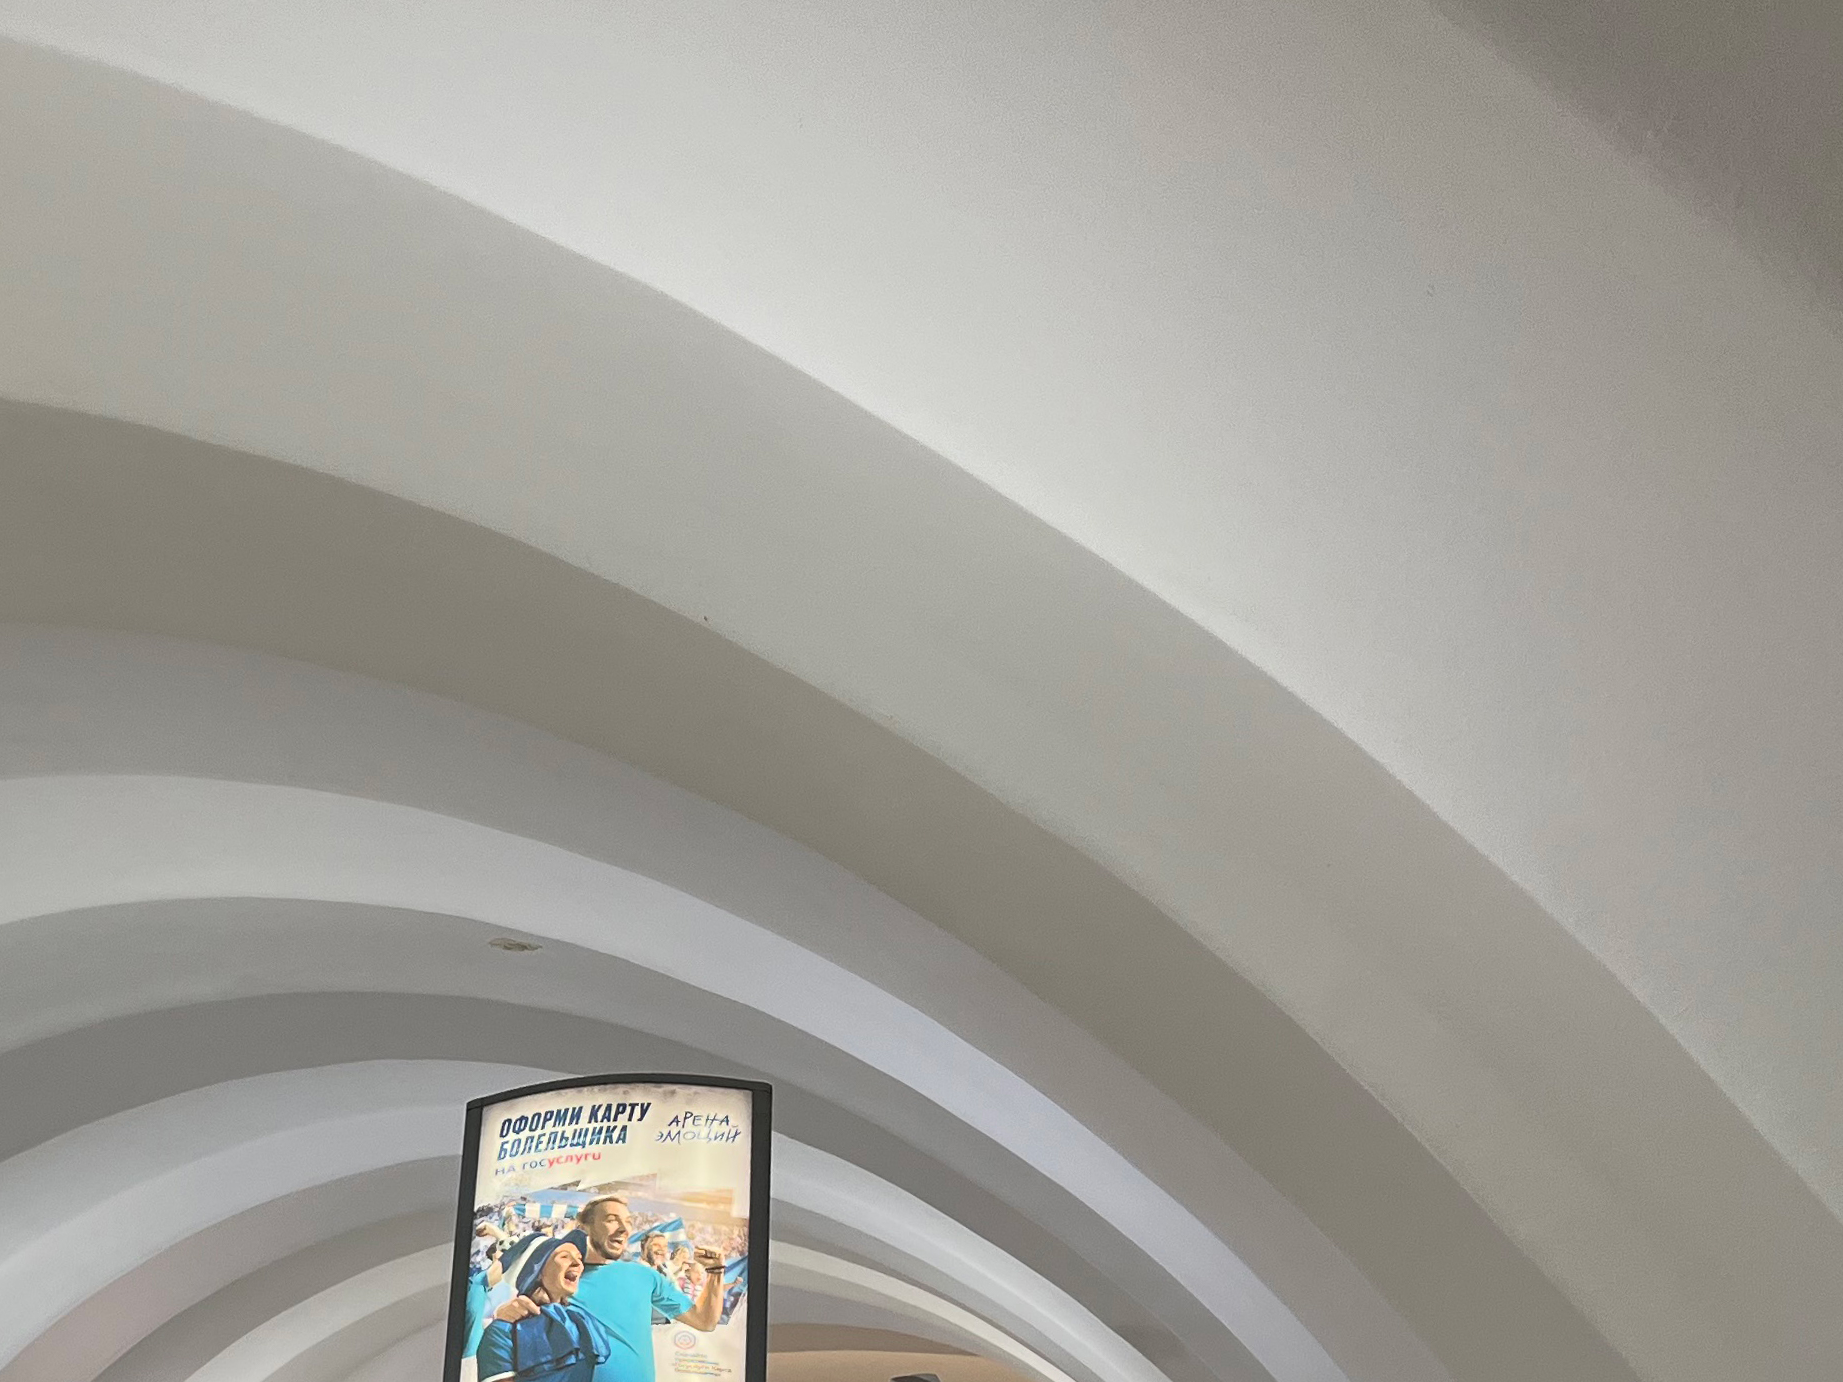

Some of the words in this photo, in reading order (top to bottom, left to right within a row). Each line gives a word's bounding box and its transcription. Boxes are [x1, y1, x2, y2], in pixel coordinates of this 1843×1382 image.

[499, 1105, 584, 1138] ОФОРМИ
[587, 1102, 652, 1124] КАРТУ
[667, 1111, 731, 1129] АРЕНА
[497, 1125, 628, 1161] БОЛЕЛЬЩИКА
